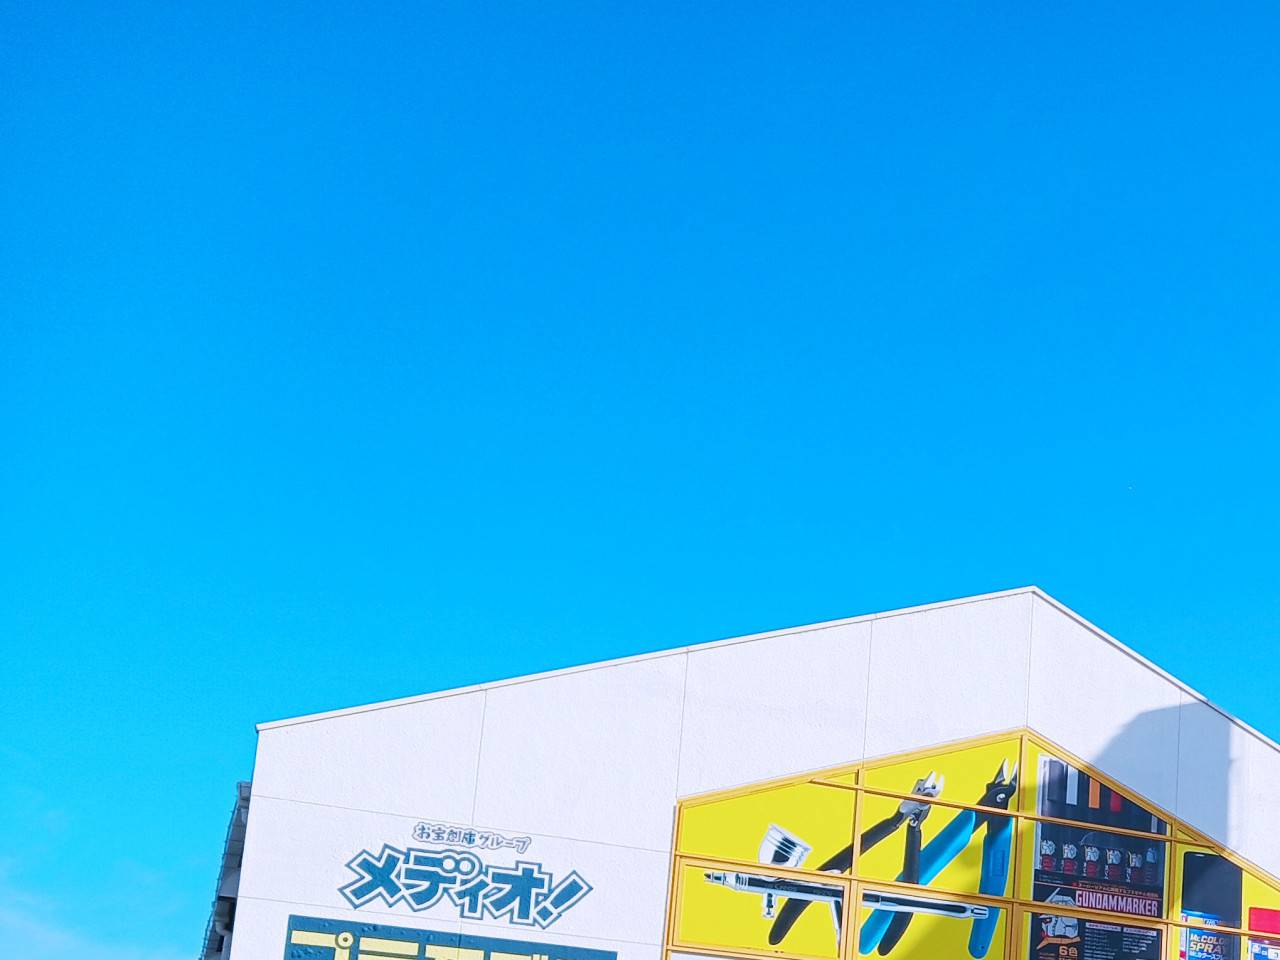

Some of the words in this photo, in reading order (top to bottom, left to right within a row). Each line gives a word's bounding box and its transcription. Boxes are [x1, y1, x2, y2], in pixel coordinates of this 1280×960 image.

[412, 822, 532, 854] お宝創庫グループ
